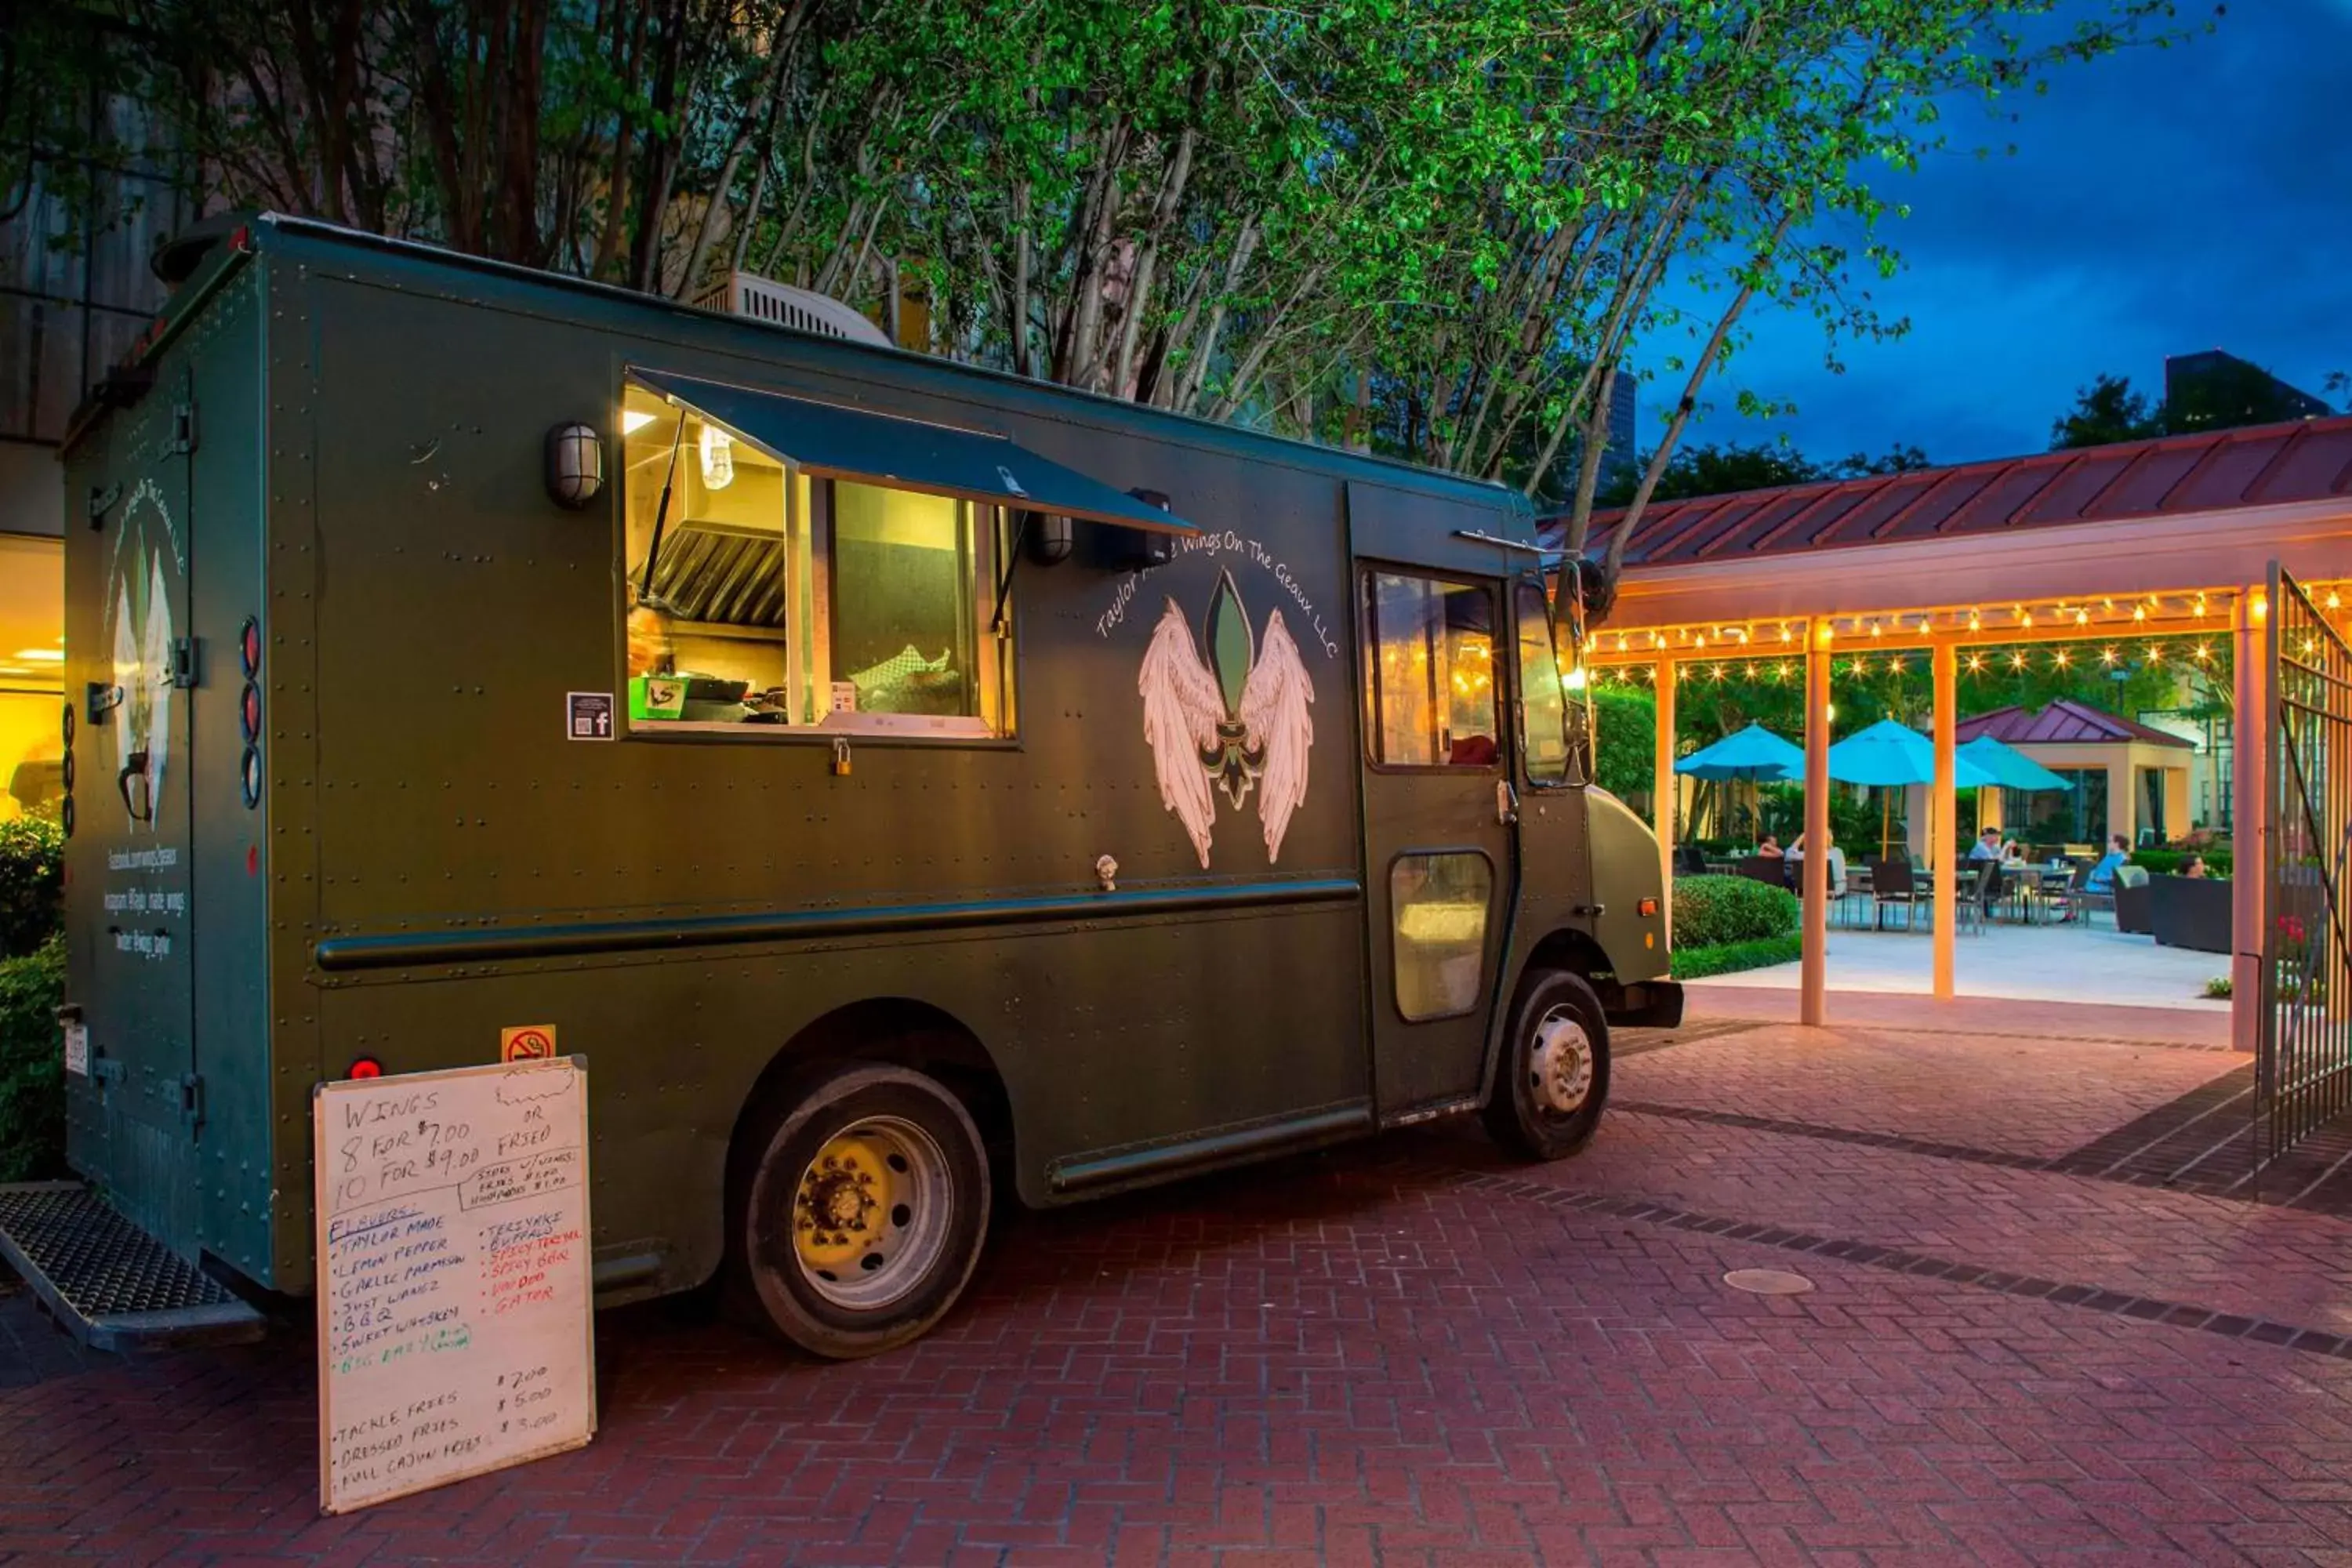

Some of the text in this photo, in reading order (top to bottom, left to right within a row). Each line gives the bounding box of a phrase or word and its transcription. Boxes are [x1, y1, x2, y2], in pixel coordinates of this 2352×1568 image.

[1097, 530, 1338, 659] Taylor Wings On The Geaux LLC
[346, 1091, 438, 1129] WINGS
[524, 1104, 545, 1123] OR
[341, 1135, 362, 1173] 8
[372, 1130, 412, 1158] FOR
[498, 1123, 551, 1156] FRIED
[336, 1175, 366, 1210] 10
[380, 1160, 419, 1189] FOR
[341, 1216, 445, 1253] TAYLOR MADE
[339, 1237, 448, 1277] LEMON PEPPER
[340, 1273, 400, 1299] GARLIC
[343, 1298, 378, 1315] JUST
[407, 1391, 458, 1417] FRIES
[341, 1434, 403, 1468] DRESSED
[412, 1418, 459, 1442] FRIES
